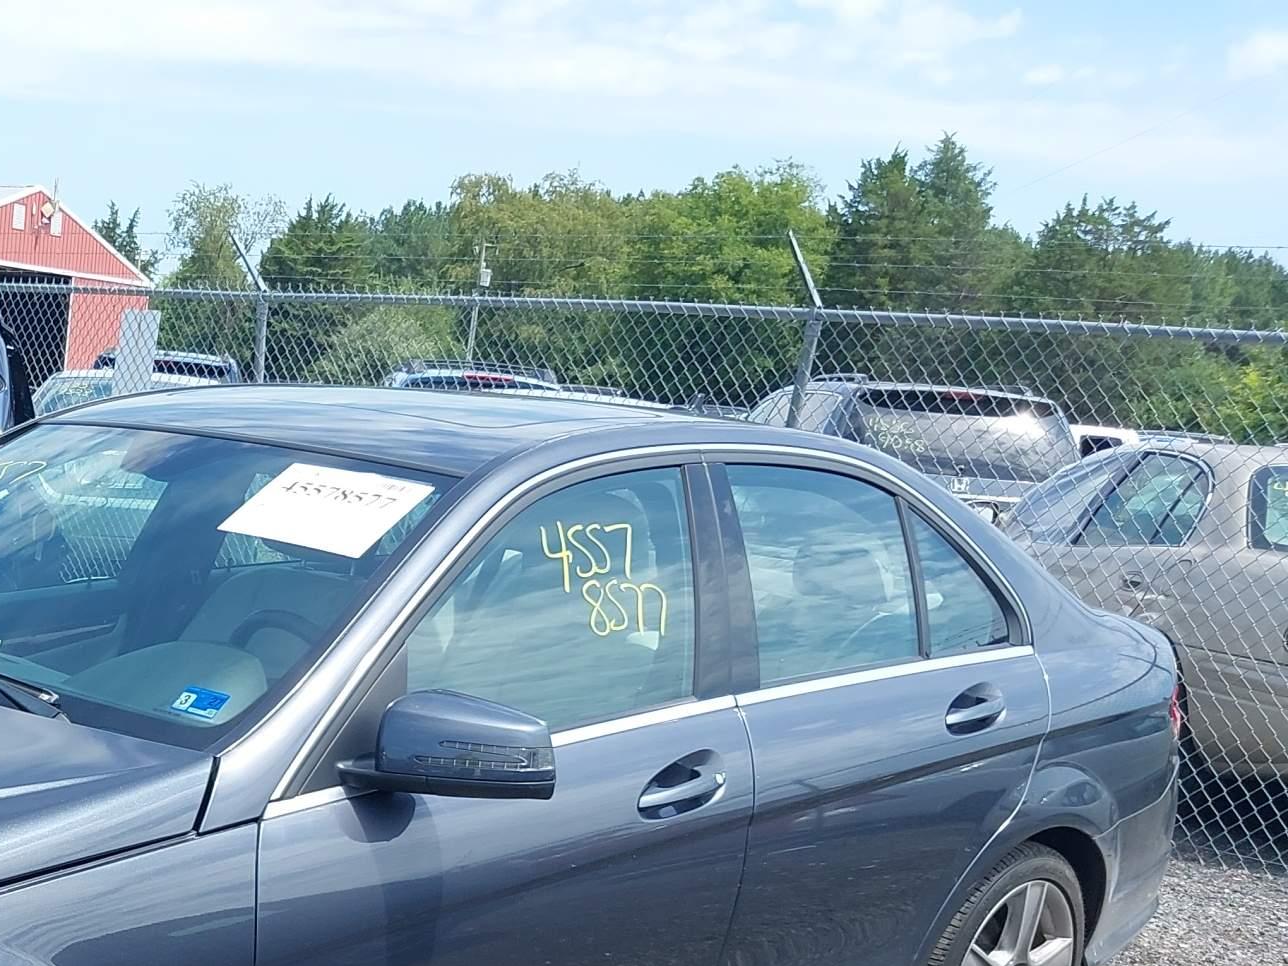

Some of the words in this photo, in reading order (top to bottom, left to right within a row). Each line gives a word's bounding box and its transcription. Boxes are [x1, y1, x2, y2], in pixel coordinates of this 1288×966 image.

[281, 481, 397, 510] 45578577
[540, 520, 632, 593] 4557
[582, 578, 667, 636] 8577
